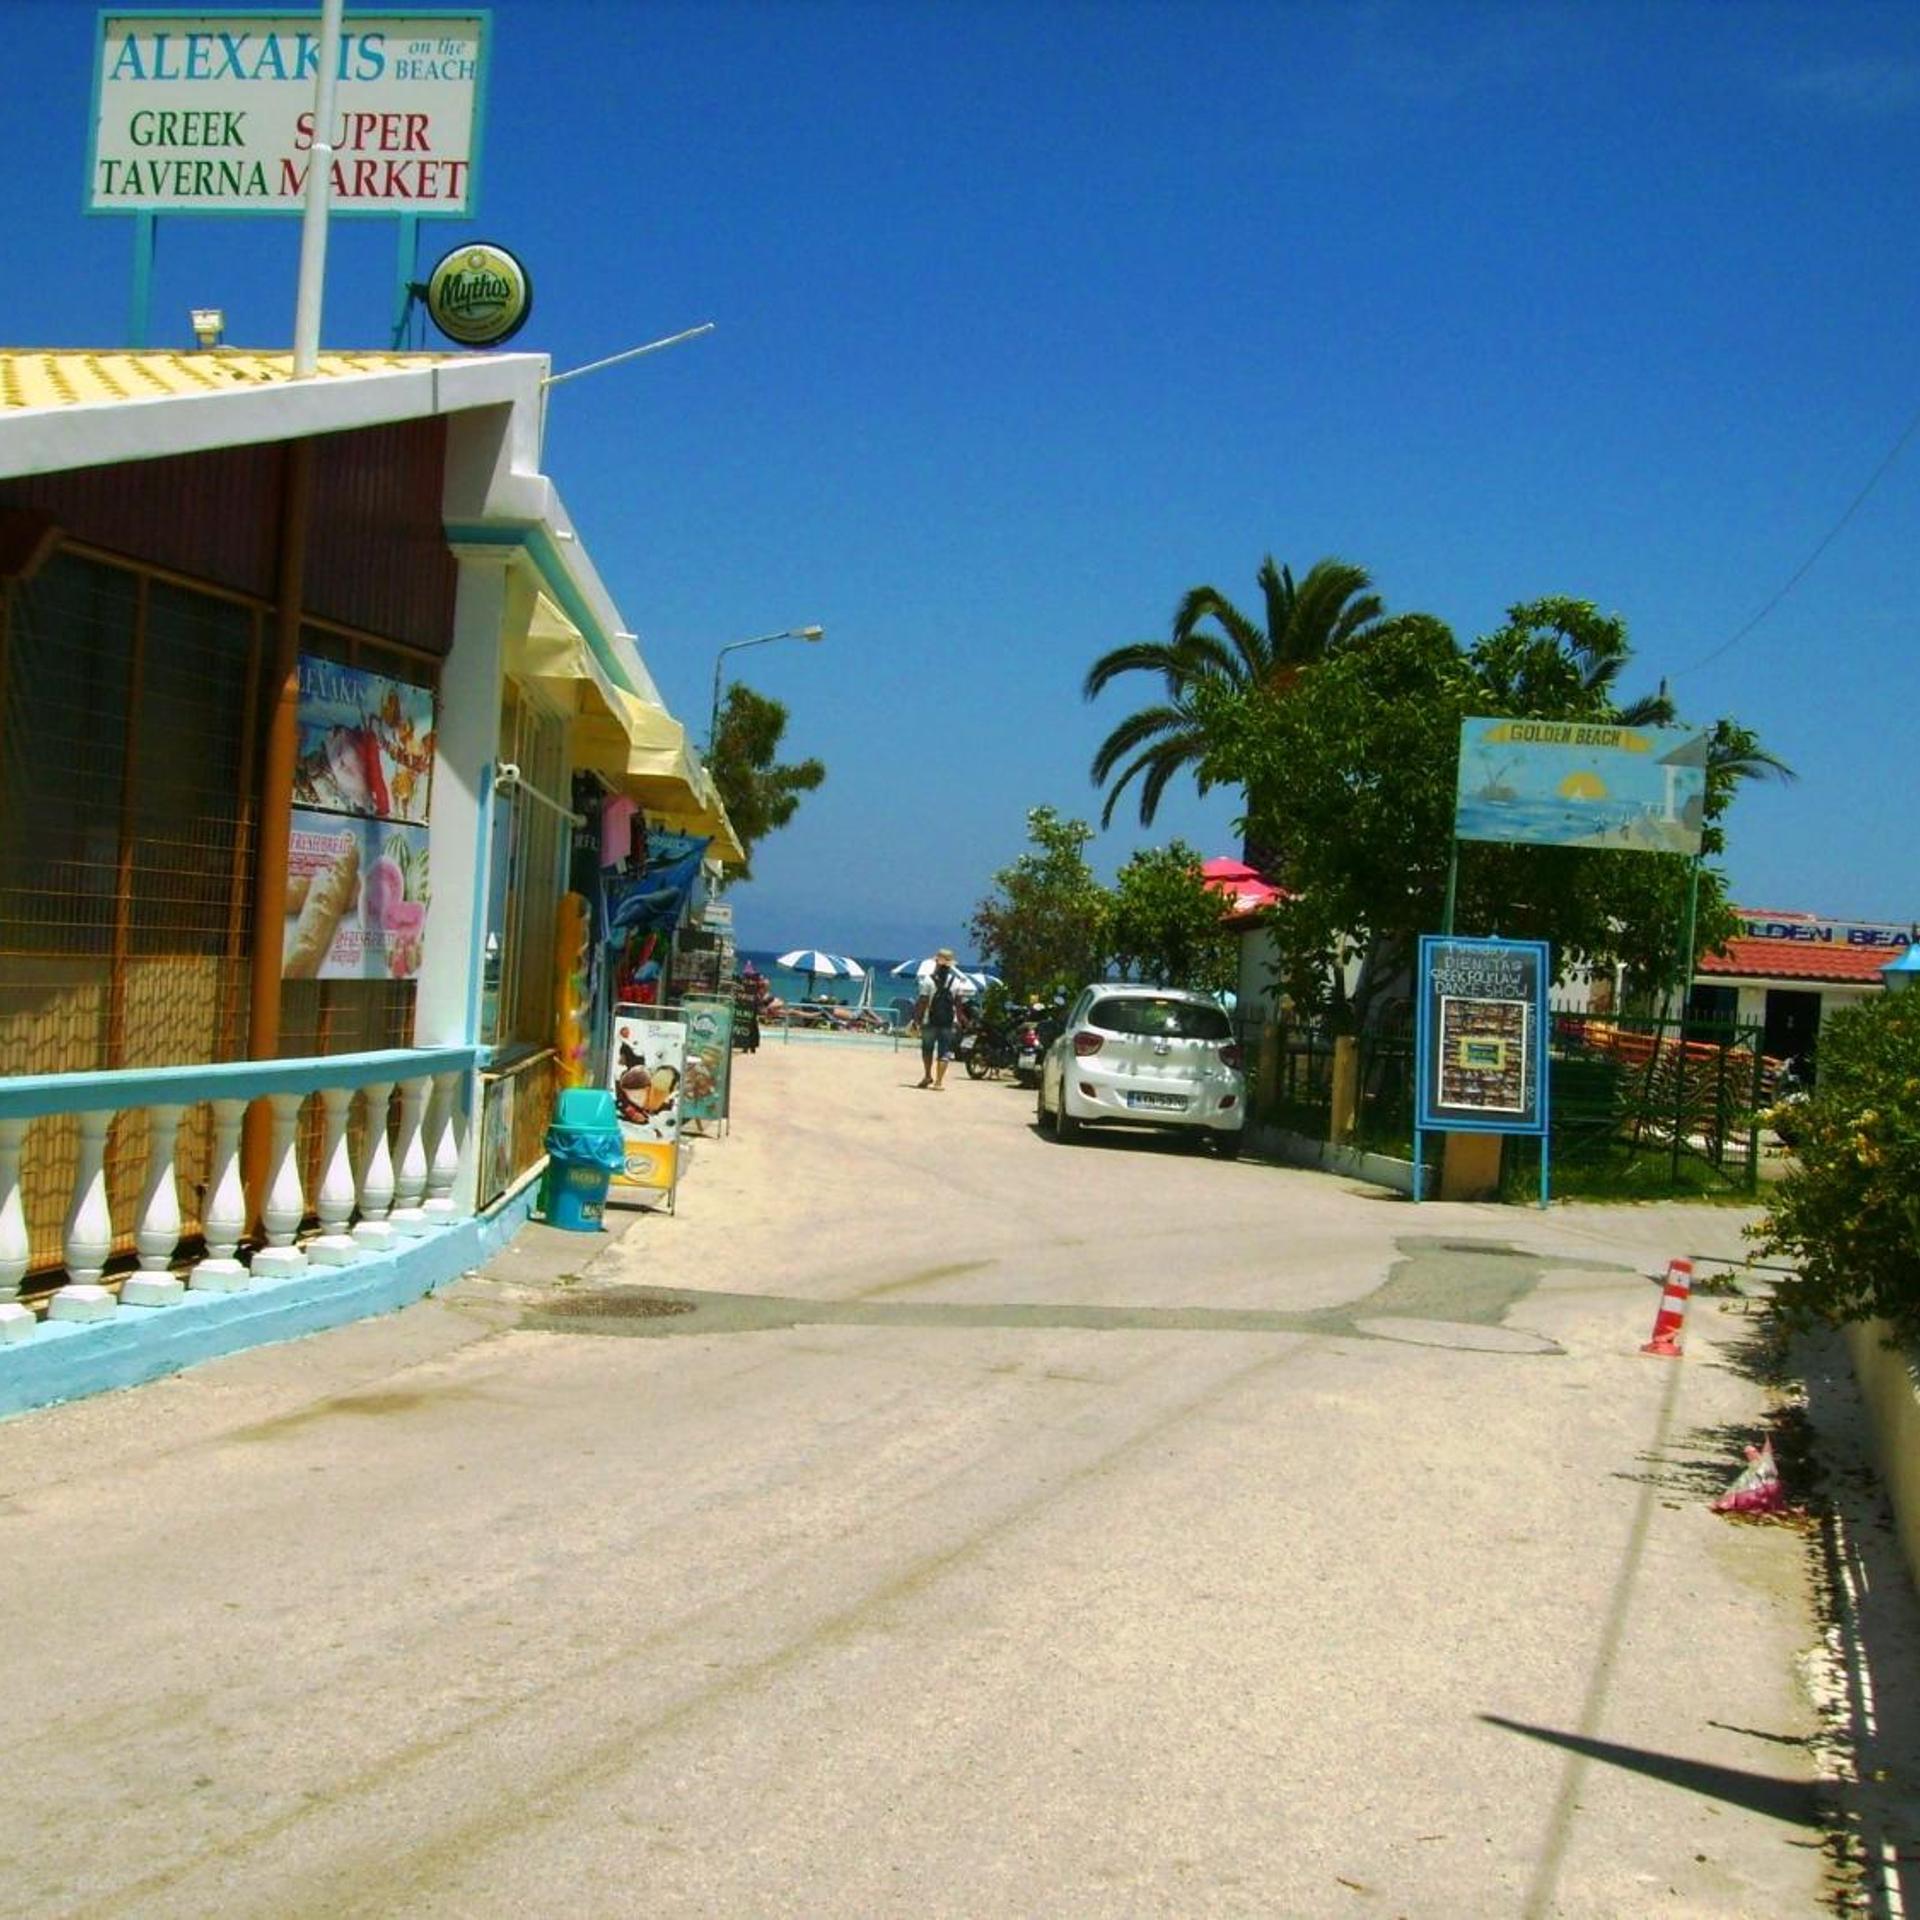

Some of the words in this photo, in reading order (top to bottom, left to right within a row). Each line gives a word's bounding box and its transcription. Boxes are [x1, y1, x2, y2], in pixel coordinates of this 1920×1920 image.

[109, 32, 386, 82] ALEXAKIS
[408, 41, 431, 55] on
[437, 36, 466, 56] the
[395, 59, 475, 81] BEACH
[130, 110, 246, 148] GREEK
[293, 112, 431, 152] SUPER
[100, 158, 268, 196] TAVERNA
[277, 157, 470, 200] MARKET
[439, 272, 512, 312] Mythos
[1510, 723, 1572, 744] GOLDEN
[1575, 726, 1620, 748] BEACH
[1748, 921, 1833, 943] LDEN
[1847, 928, 1912, 947] BEA
[1435, 981, 1480, 998] DANCE
[1484, 983, 1529, 999] SHOW
